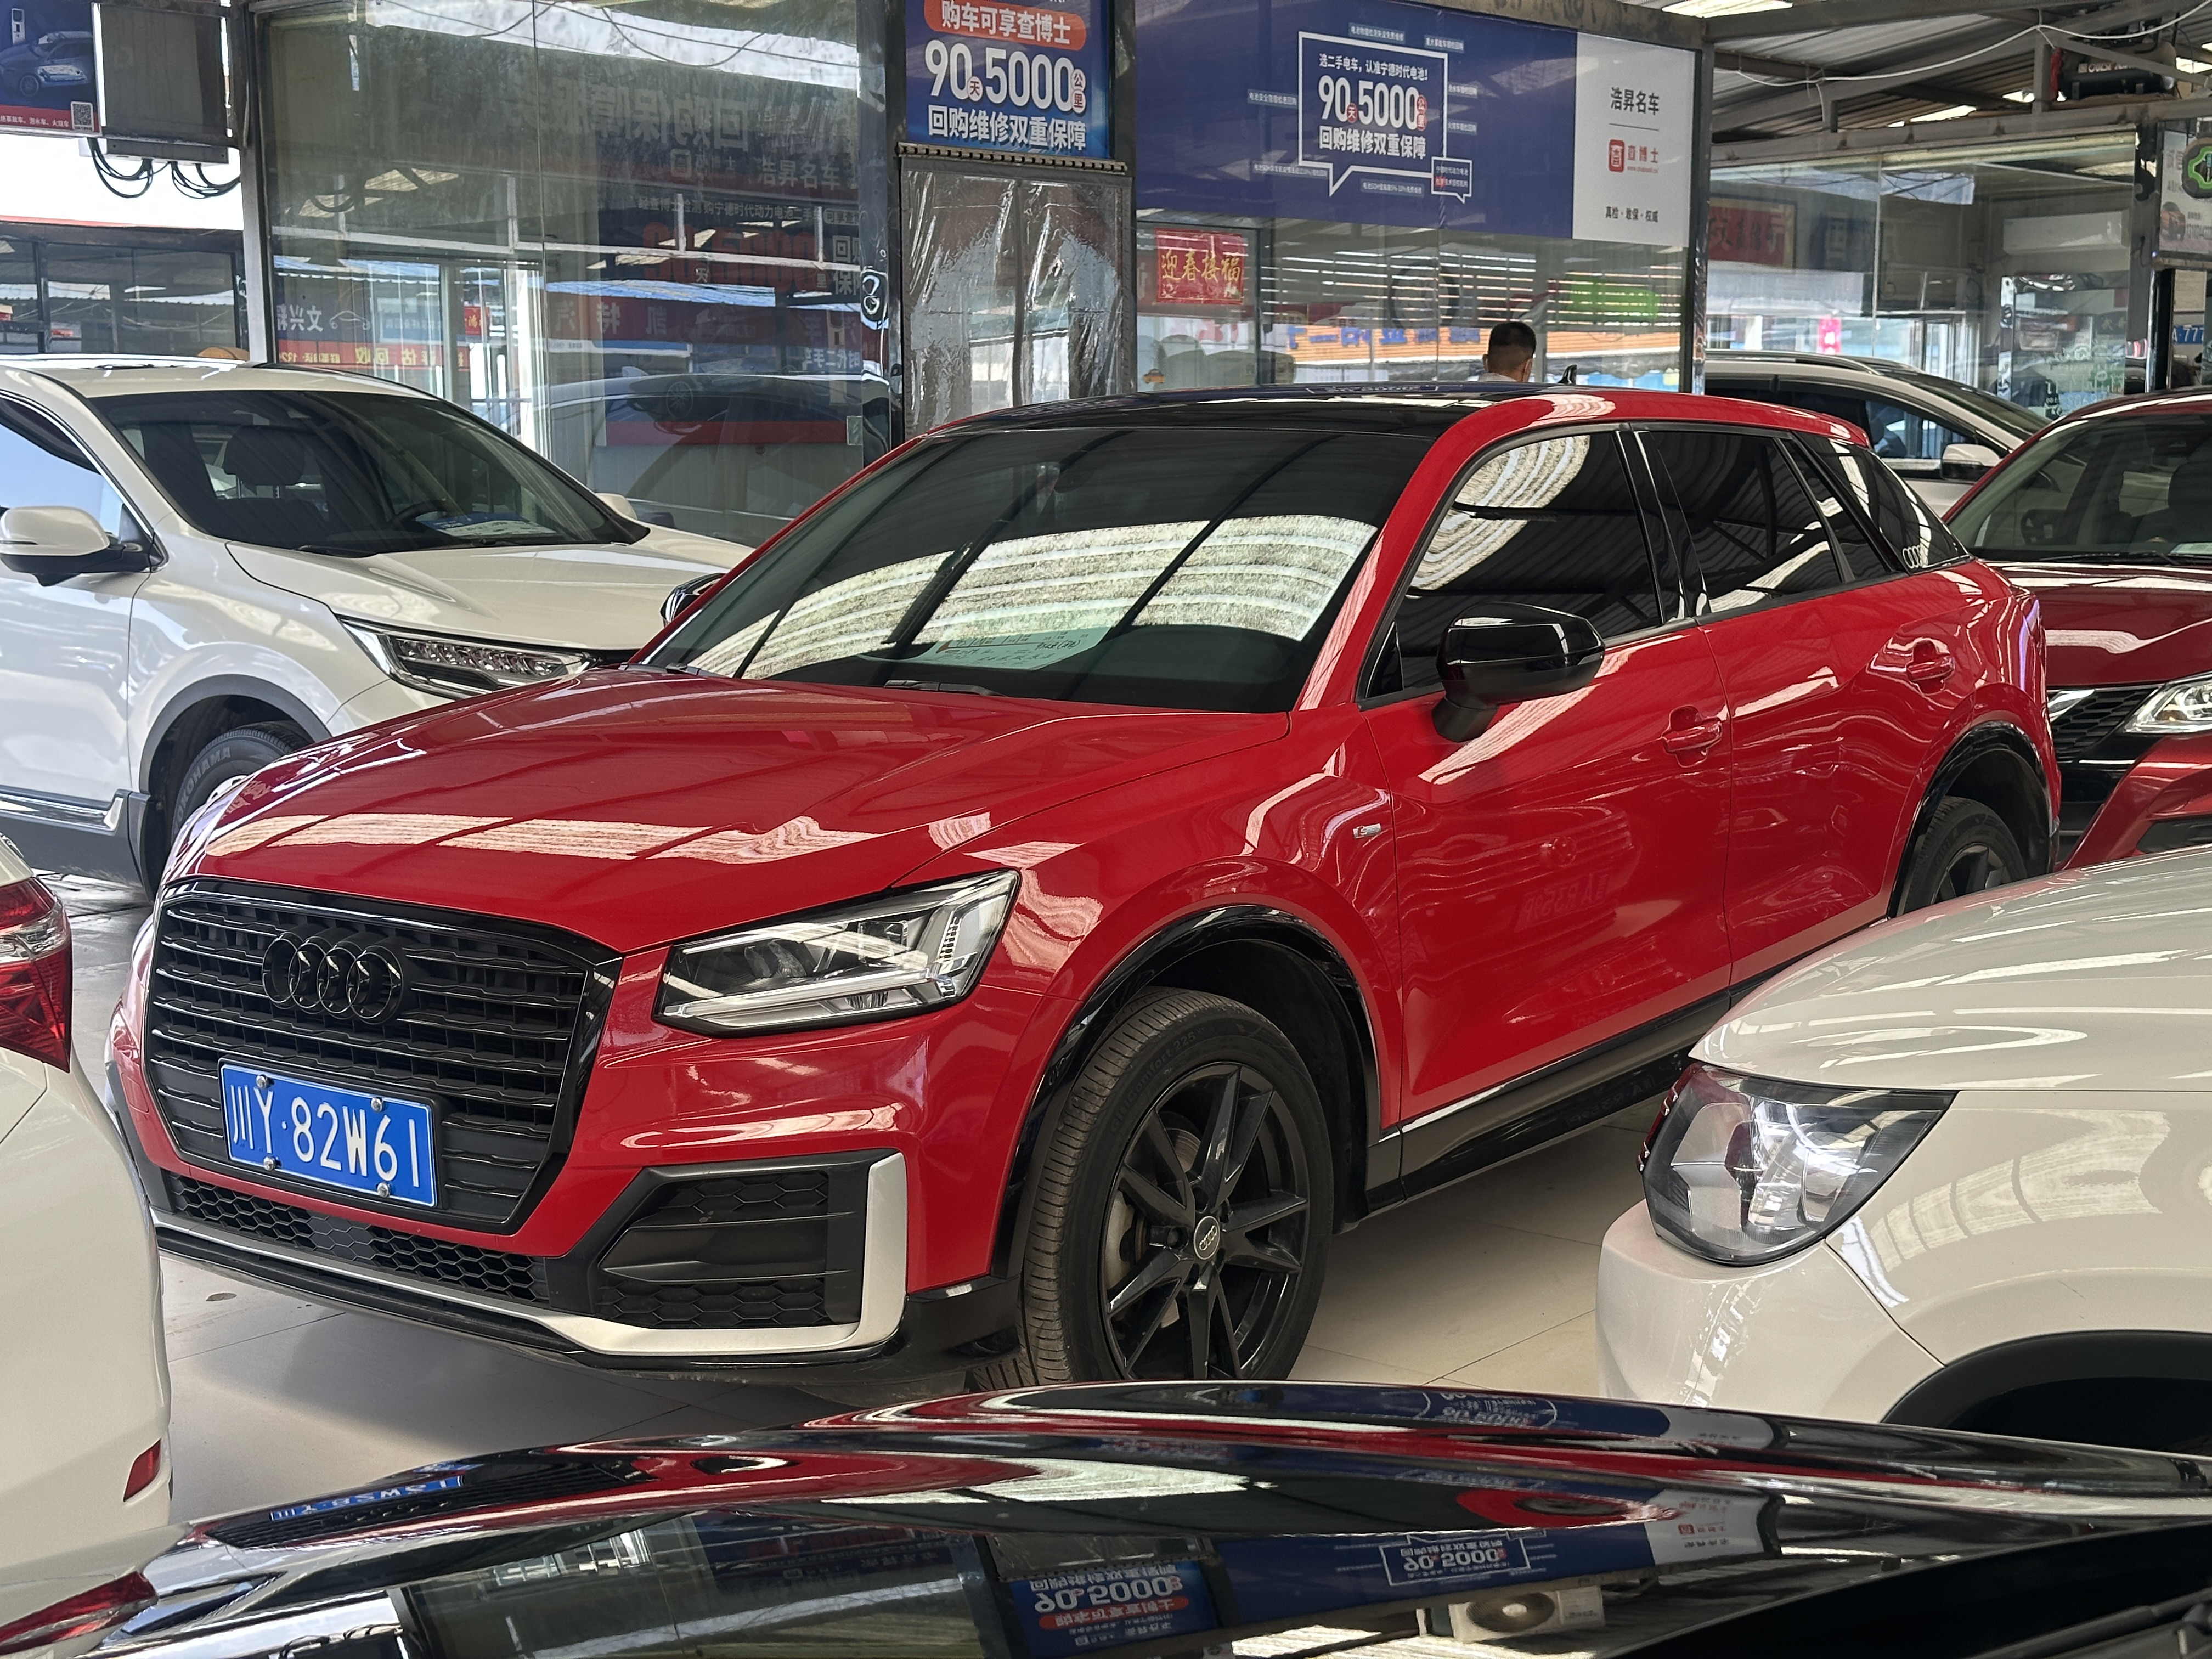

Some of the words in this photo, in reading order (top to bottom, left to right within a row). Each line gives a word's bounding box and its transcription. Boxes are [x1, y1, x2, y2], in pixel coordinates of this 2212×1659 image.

[941, 2, 1071, 45] 购车可享查博士
[1611, 87, 1659, 116] 浩昇名车
[928, 105, 1086, 150] 回购维修双重保障
[1319, 126, 1426, 159] 回购维修双重保障
[230, 1085, 419, 1188] 川Y·82W61
